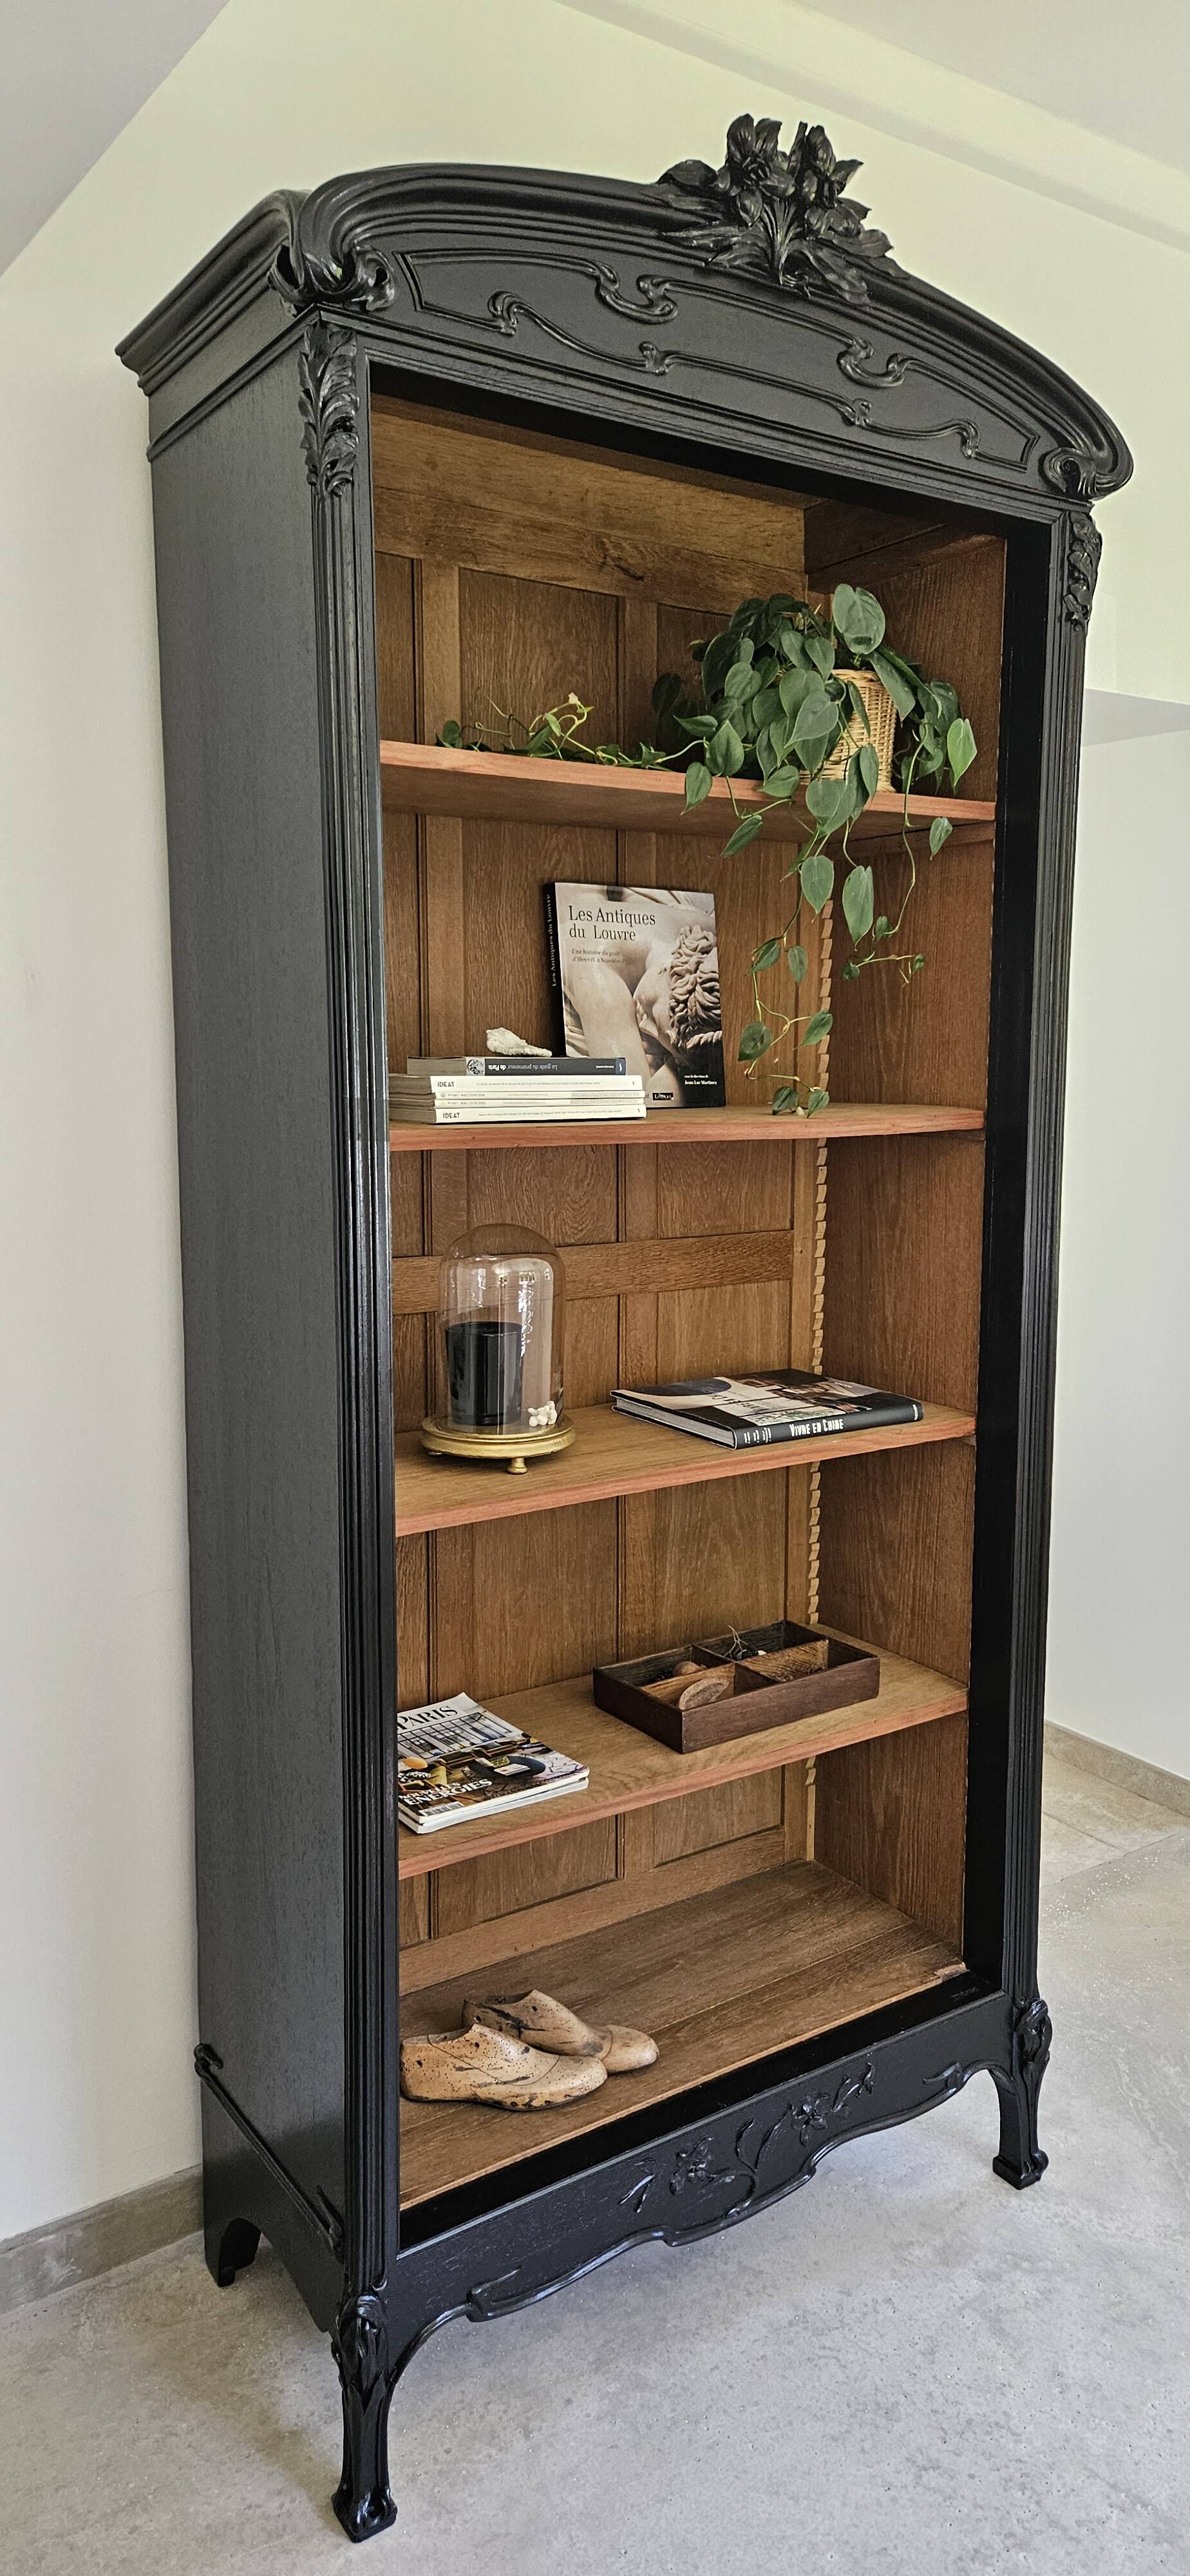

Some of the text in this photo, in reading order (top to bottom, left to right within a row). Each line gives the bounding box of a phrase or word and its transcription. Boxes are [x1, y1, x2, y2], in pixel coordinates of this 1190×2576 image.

[568, 905, 656, 927] Les Antiques
[548, 923, 553, 934] du
[569, 923, 636, 941] du Louvre
[397, 1706, 458, 1730] PARIS
[404, 1779, 493, 1805] ENERGIES
